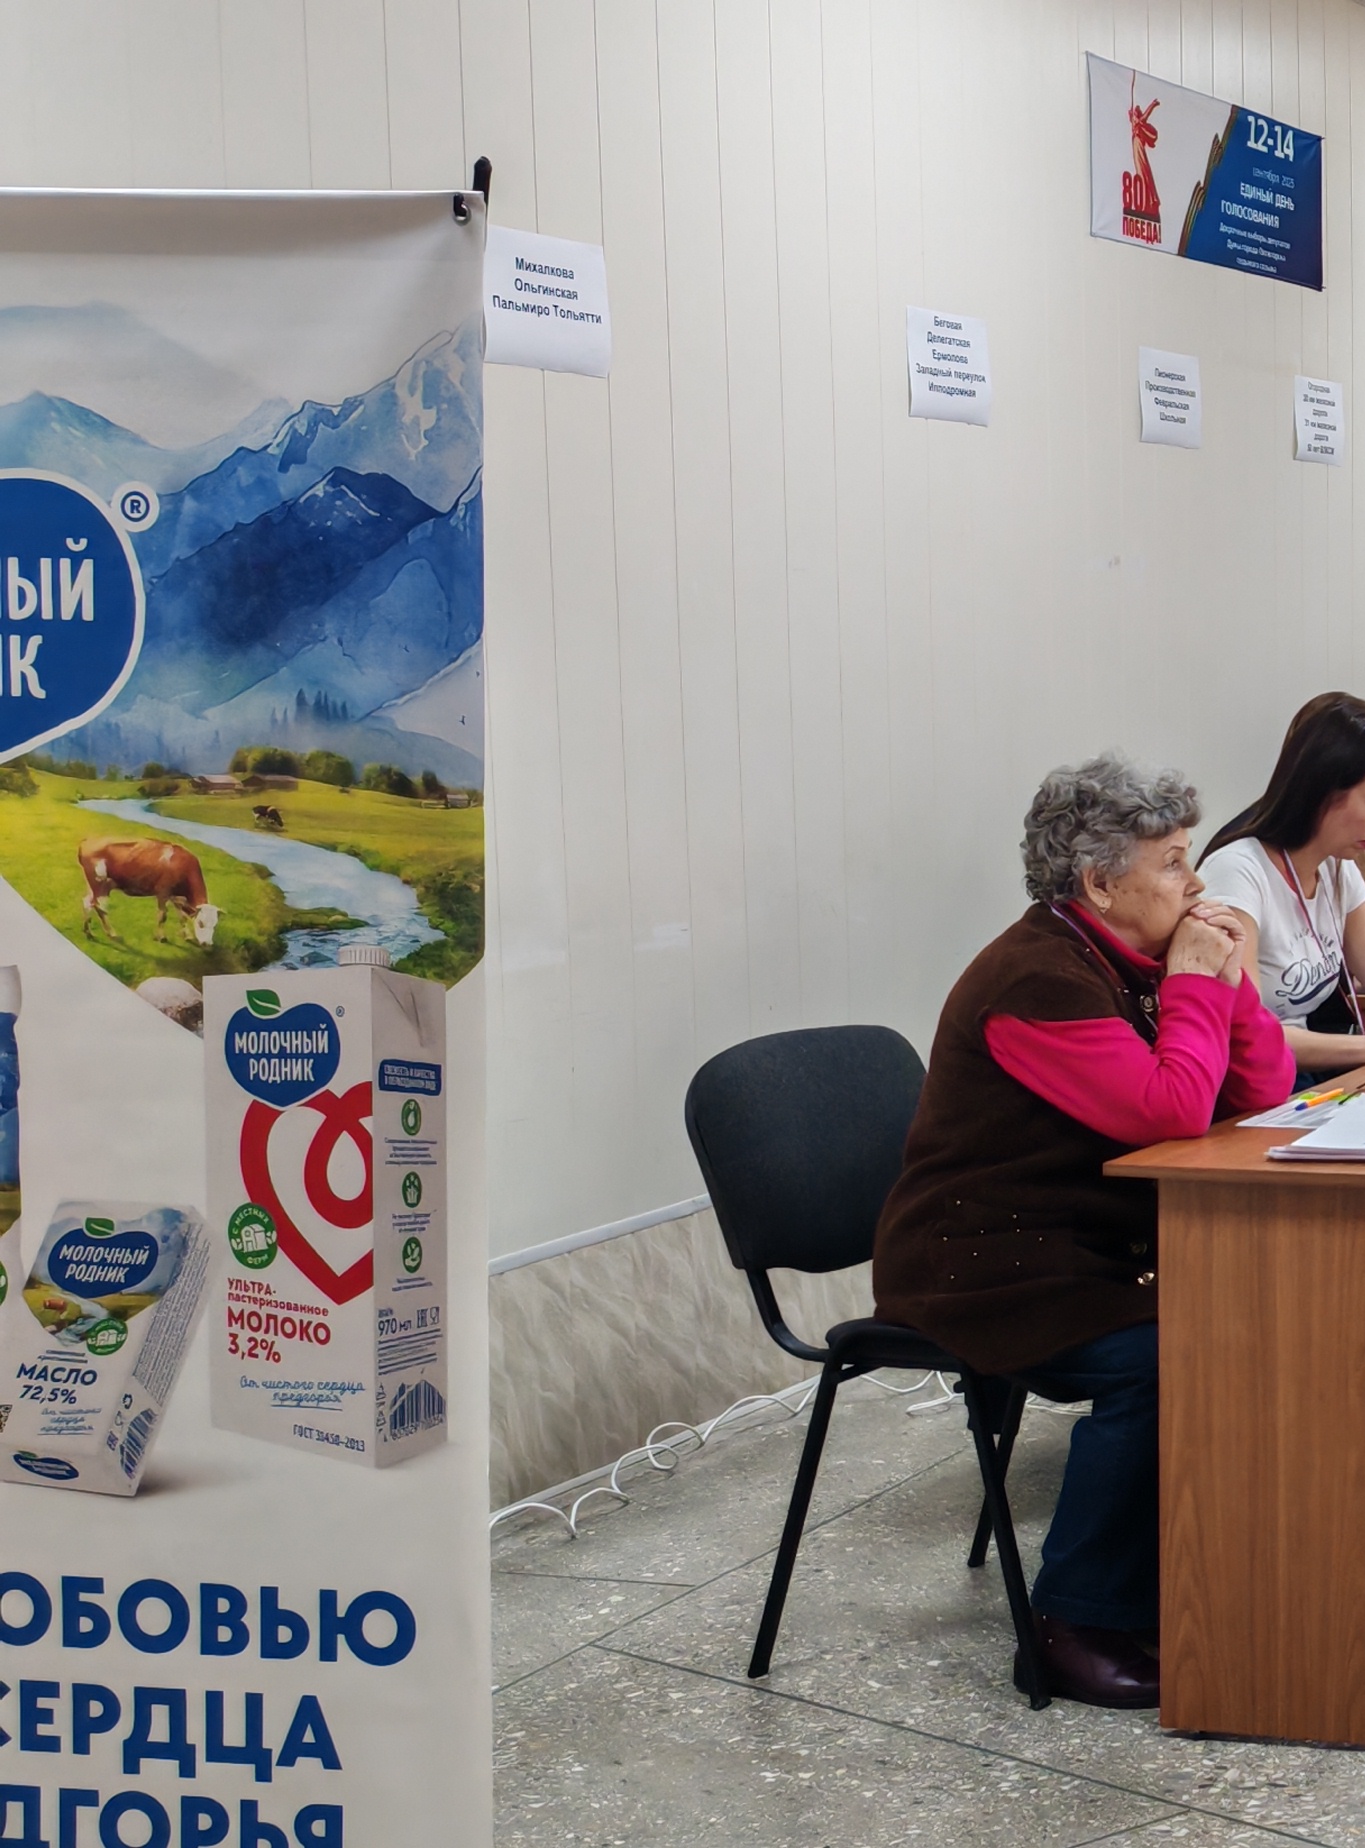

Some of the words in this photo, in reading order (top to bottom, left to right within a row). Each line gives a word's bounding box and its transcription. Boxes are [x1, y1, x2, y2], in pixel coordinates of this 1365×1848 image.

[1247, 115, 1294, 162] 12-14
[1241, 182, 1273, 204] ЕДИНЫЙ
[1275, 194, 1294, 211] ДЕНЬ
[1221, 200, 1279, 228] ГОЛОСОВАНИЯ
[1123, 216, 1161, 245] ПОБЕДА!
[515, 257, 574, 279] Михалкова
[514, 278, 578, 300] Ольгинская
[492, 295, 550, 317] Пальмиро
[552, 304, 602, 324] Тольятти
[0, 537, 94, 621] ЫЙ
[0, 634, 46, 699] К
[234, 1023, 329, 1054] МОЛОЧНЫЙ
[249, 1058, 315, 1084] РОДНИК
[59, 1244, 150, 1265] МОЛОЧНЫЙ
[65, 1263, 130, 1283] РОДНИК
[227, 1277, 277, 1296] УЛЬТРА-
[227, 1292, 329, 1317] пастеризованное
[227, 1306, 331, 1346] МОЛОКО
[378, 1317, 397, 1337] 970
[227, 1332, 282, 1363] 3,2%
[16, 1363, 98, 1386] МАСЛО
[19, 1385, 77, 1405] 72,5%
[293, 1424, 314, 1439] ГОСТ
[0, 1680, 343, 1783] ЕРДЦА
